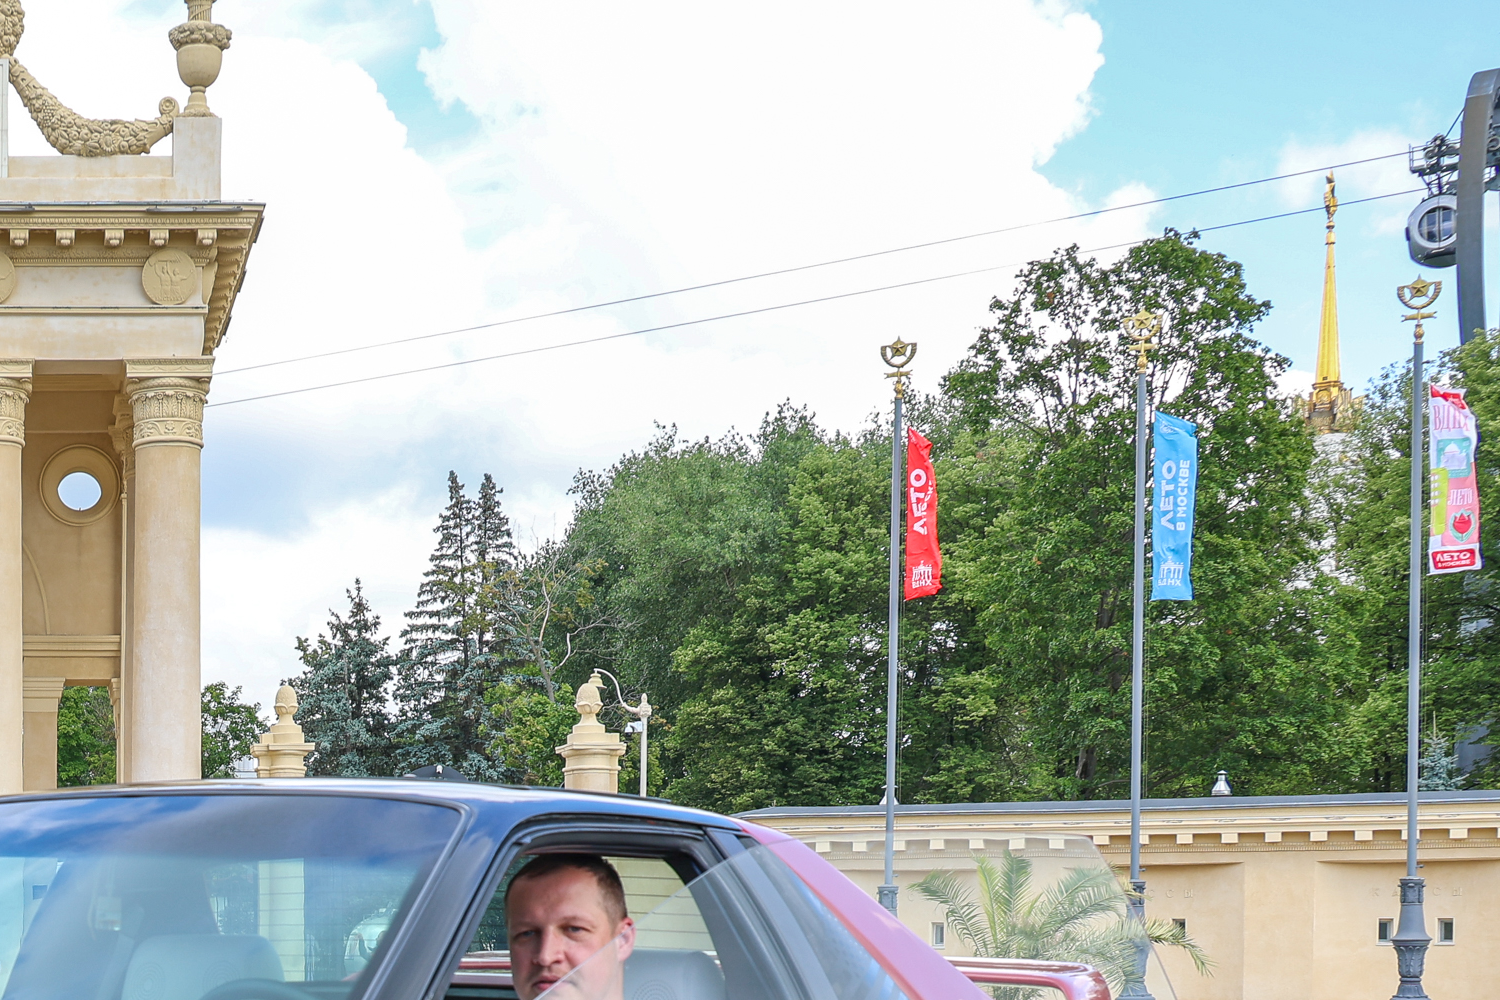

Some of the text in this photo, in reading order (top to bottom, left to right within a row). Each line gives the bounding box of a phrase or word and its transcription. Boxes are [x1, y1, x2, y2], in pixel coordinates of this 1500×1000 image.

[909, 468, 928, 535] ЛЕТО
[1160, 460, 1177, 531] ЛЕТО
[1176, 459, 1191, 531] В МОСКВЕ
[1436, 551, 1471, 562] ЛЕТО
